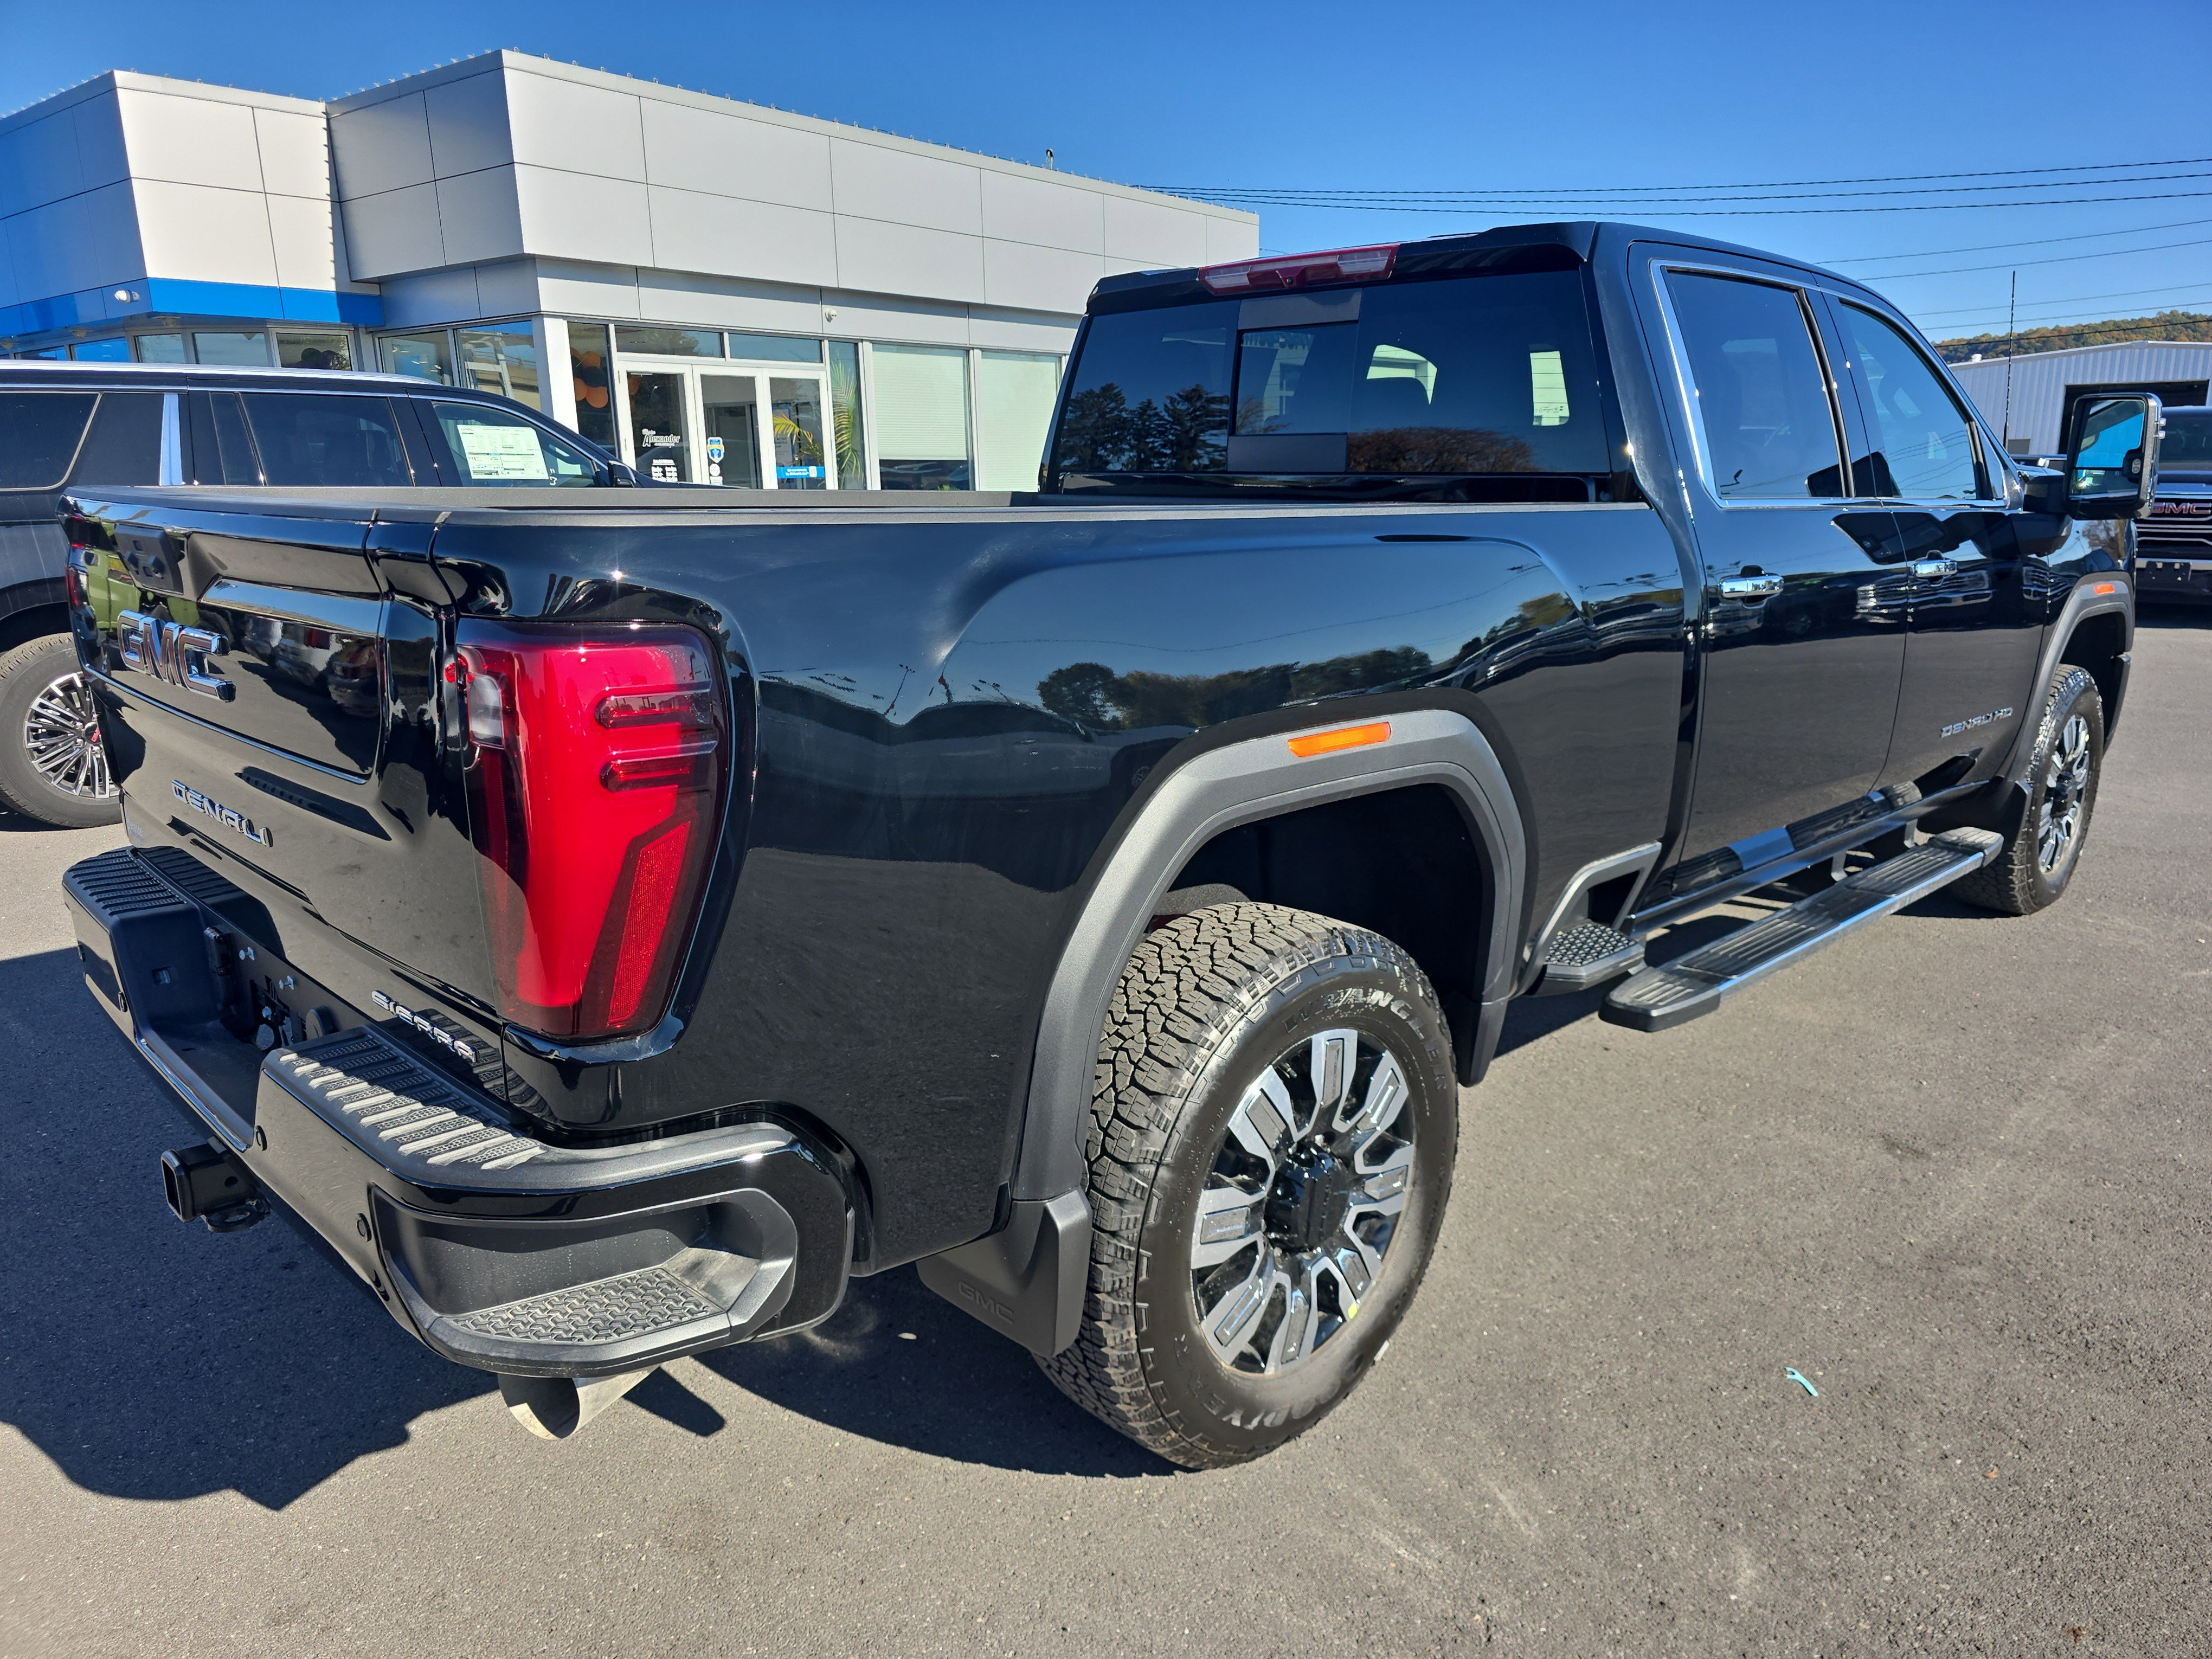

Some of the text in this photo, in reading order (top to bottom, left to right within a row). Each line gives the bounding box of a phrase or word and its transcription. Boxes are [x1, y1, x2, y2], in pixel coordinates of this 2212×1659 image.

[642, 433, 680, 447] Alexander
[117, 609, 236, 703] GMC
[171, 779, 273, 847] DENALI
[371, 990, 480, 1063] SIERRA
[957, 1279, 1015, 1326] GMC
